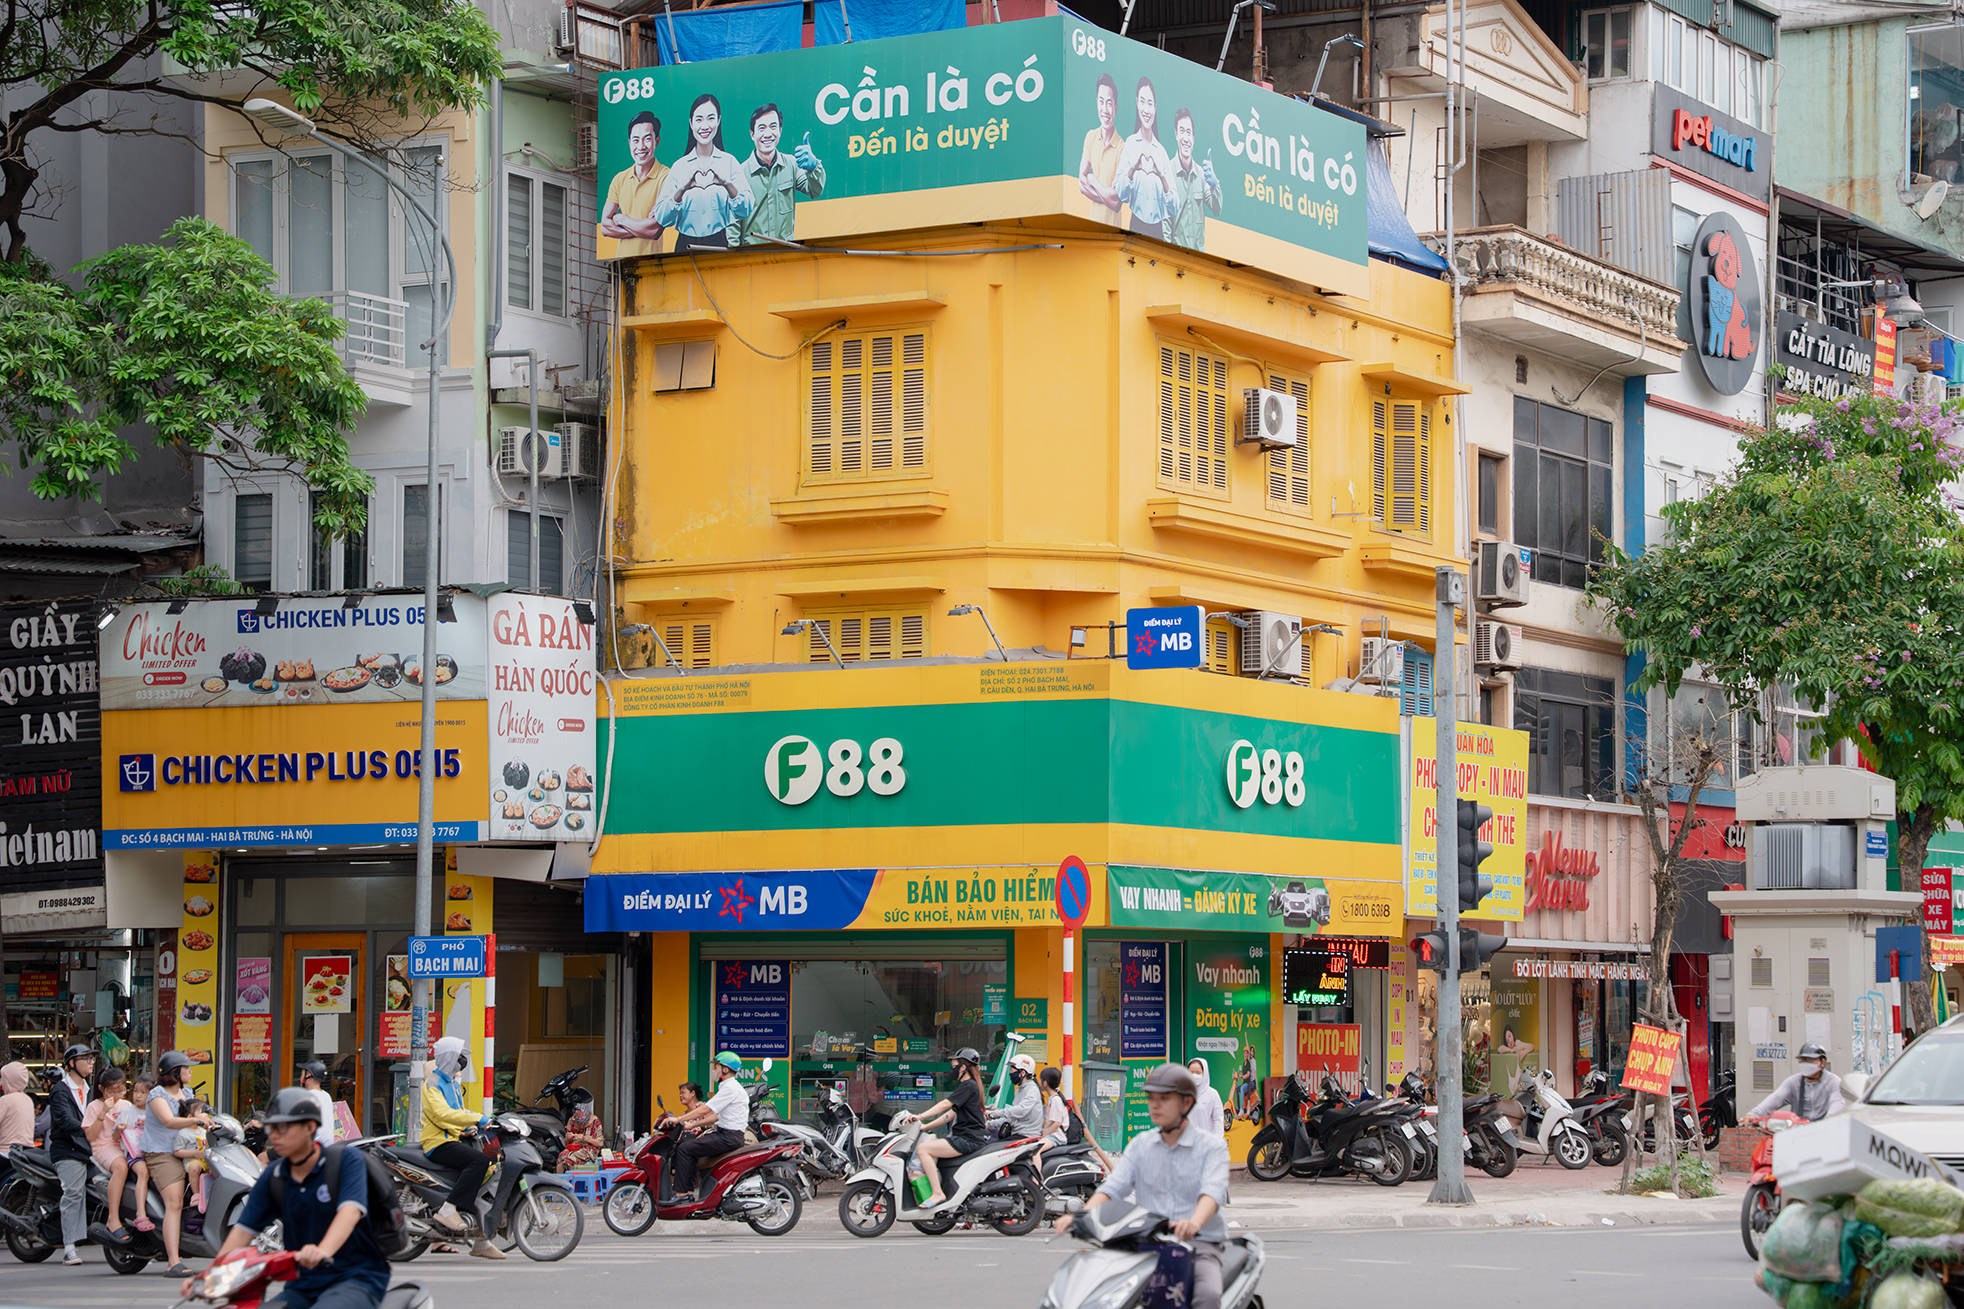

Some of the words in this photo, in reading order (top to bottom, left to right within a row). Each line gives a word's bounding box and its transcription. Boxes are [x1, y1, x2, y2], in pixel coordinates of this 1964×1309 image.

[1072, 28, 1106, 62] F88
[603, 77, 655, 104] F88
[814, 65, 910, 126] Cần
[926, 65, 968, 113] là
[984, 54, 1044, 106] có
[848, 127, 897, 158] Đến
[905, 126, 929, 152] là
[937, 118, 1009, 155] duyệt
[1222, 107, 1281, 172] Cần
[1289, 135, 1315, 182] là
[1323, 152, 1357, 196] có
[1674, 108, 1758, 172] petmart
[1244, 173, 1275, 205] Đến
[1279, 185, 1294, 211] là
[1298, 193, 1339, 230] duyệt
[1788, 321, 1816, 359] CẮT
[1839, 344, 1871, 377] LÔNG
[1785, 366, 1810, 394] SPA
[264, 608, 346, 630] CHICKEN
[352, 607, 400, 626] PLUS
[494, 601, 532, 647] GÀ
[539, 606, 591, 651] RÁN
[1144, 618, 1161, 627] ĐIỂM
[1162, 618, 1173, 627] ĐẠI
[1174, 617, 1182, 626] LÝ
[123, 610, 207, 661] Chicken
[1161, 632, 1192, 651] MB
[141, 660, 171, 669] LIMITED
[173, 659, 197, 668] OFFER
[0, 655, 97, 705] QUỲNH
[495, 659, 535, 693] HÀN
[541, 658, 592, 698] QUỐC
[20, 710, 78, 745] LAN
[498, 700, 544, 737] Chicken
[1476, 731, 1494, 756] HÒA
[163, 753, 300, 785] CHICKEN
[306, 750, 390, 781] PLUS
[764, 734, 906, 805] F88
[1225, 738, 1307, 809] F88
[1489, 767, 1500, 797] IN
[1502, 762, 1525, 799] MÀU
[42, 769, 72, 794] NỮ
[121, 835, 137, 844] ĐC:
[139, 831, 151, 844] SỐ
[153, 834, 159, 843] 4
[161, 832, 185, 845] BẠCH
[186, 832, 204, 842] MAI
[211, 832, 227, 841] HAI
[229, 829, 241, 841] BÀ
[242, 830, 274, 841] TRƯNG
[281, 828, 294, 840] HÀ
[296, 828, 312, 843] NỘI
[385, 829, 400, 838] ĐT:
[401, 829, 417, 837] 033
[438, 826, 460, 837] 7767
[1497, 808, 1515, 845] THẺ
[1544, 830, 1600, 877] Venus
[907, 875, 948, 904] BÁN
[956, 871, 996, 904] BẢO
[1004, 868, 1056, 902] HIỂM
[1923, 872, 1946, 884] SỬA
[623, 890, 661, 910] ĐIỂM
[665, 894, 690, 914] ĐẠI
[695, 890, 712, 909] LÝ
[760, 885, 808, 915] MB
[1120, 886, 1139, 909] VAY
[1143, 888, 1181, 911] NHANH
[1194, 887, 1225, 914] ĐĂNG
[1227, 887, 1242, 914] KÝ
[1243, 894, 1257, 915] XE
[1921, 888, 1949, 900] CHỮA
[884, 908, 910, 922] SỨC
[914, 906, 952, 923] KHOẺ,
[957, 904, 986, 921] NẰM
[991, 905, 1024, 924] VIỆN,
[1028, 909, 1045, 920] TAI
[1350, 903, 1369, 917] 1800
[1928, 905, 1942, 915] XE
[1925, 918, 1947, 930] MÁY
[442, 940, 465, 951] PHỐ
[1129, 946, 1142, 957] ĐIỂM
[1152, 948, 1158, 957] LÝ
[415, 957, 450, 975] BẠCH
[453, 957, 478, 971] MAI
[750, 964, 782, 984] MB
[1141, 965, 1161, 984] MB
[1196, 962, 1219, 987] Vay
[1223, 964, 1260, 984] nhanh
[1022, 1003, 1036, 1016] 02
[1406, 990, 1413, 1002] 01
[1196, 1008, 1228, 1032] Đăng
[1230, 1008, 1243, 1031] ký
[1247, 1014, 1260, 1028] xe
[1299, 1028, 1359, 1056] PHOTO-IN
[1633, 1026, 1658, 1046] PHOTO
[1658, 1032, 1680, 1051] COPY
[1629, 1049, 1654, 1075] CHỤP
[1653, 1050, 1674, 1077] ẢNH
